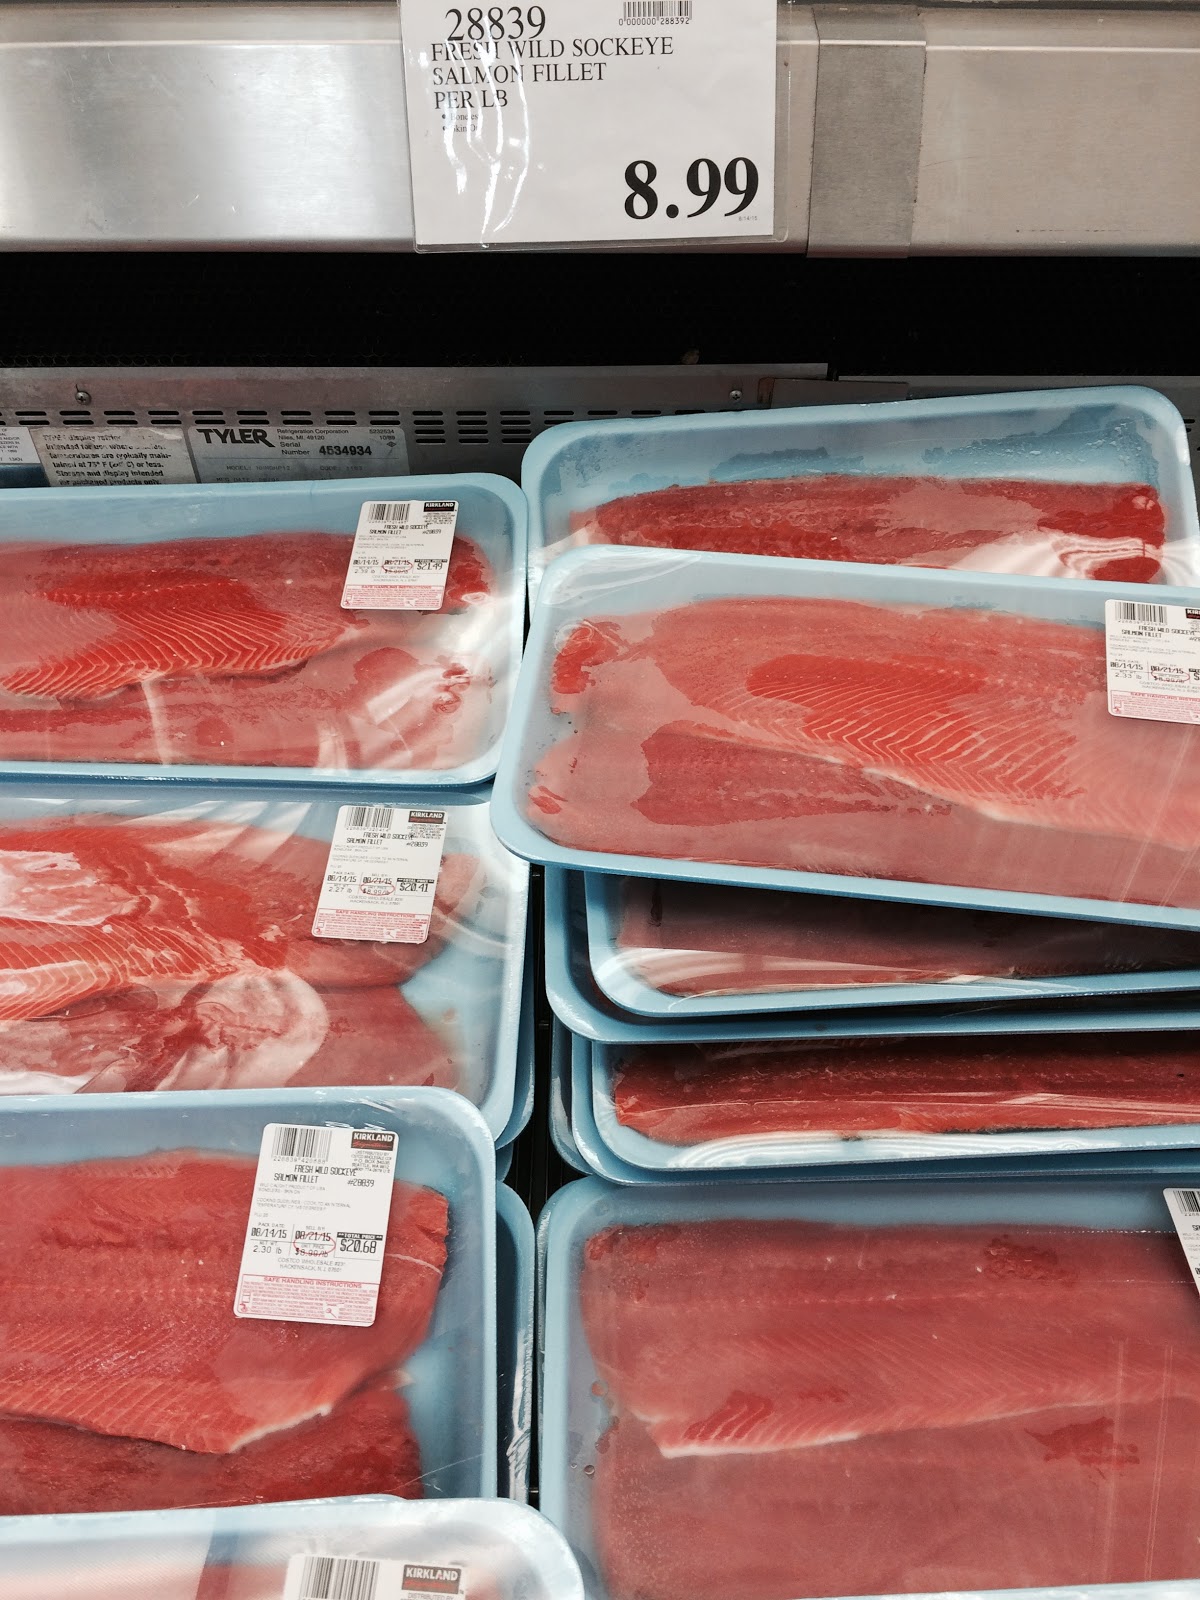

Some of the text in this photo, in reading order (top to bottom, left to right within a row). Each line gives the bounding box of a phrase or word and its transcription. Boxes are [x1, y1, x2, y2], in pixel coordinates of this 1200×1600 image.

[445, 5, 546, 41] 28839
[626, 18, 656, 26] 000000
[660, 16, 690, 25] 288392
[431, 36, 674, 61] FRESH WILD SOCKEYE
[433, 62, 607, 86] SALMON FILLET
[434, 89, 508, 109] PER LB
[624, 157, 758, 220] 8.99
[196, 429, 276, 448] TYLER
[400, 883, 428, 892] $20.41
[354, 1132, 393, 1142] KIRKLAND
[294, 1165, 313, 1173] FRESH
[315, 1166, 328, 1174] WILD
[330, 1167, 358, 1176] SOCKEYE
[274, 1173, 319, 1184] SALMON FILLET
[347, 1179, 374, 1187] #28839
[251, 1228, 287, 1238] 08/14/15
[295, 1230, 331, 1241] 08/21/15
[340, 1238, 377, 1253] $20.68
[316, 1280, 362, 1288] INSTRUCTIONS
[406, 1567, 458, 1581] KIRKLAND
